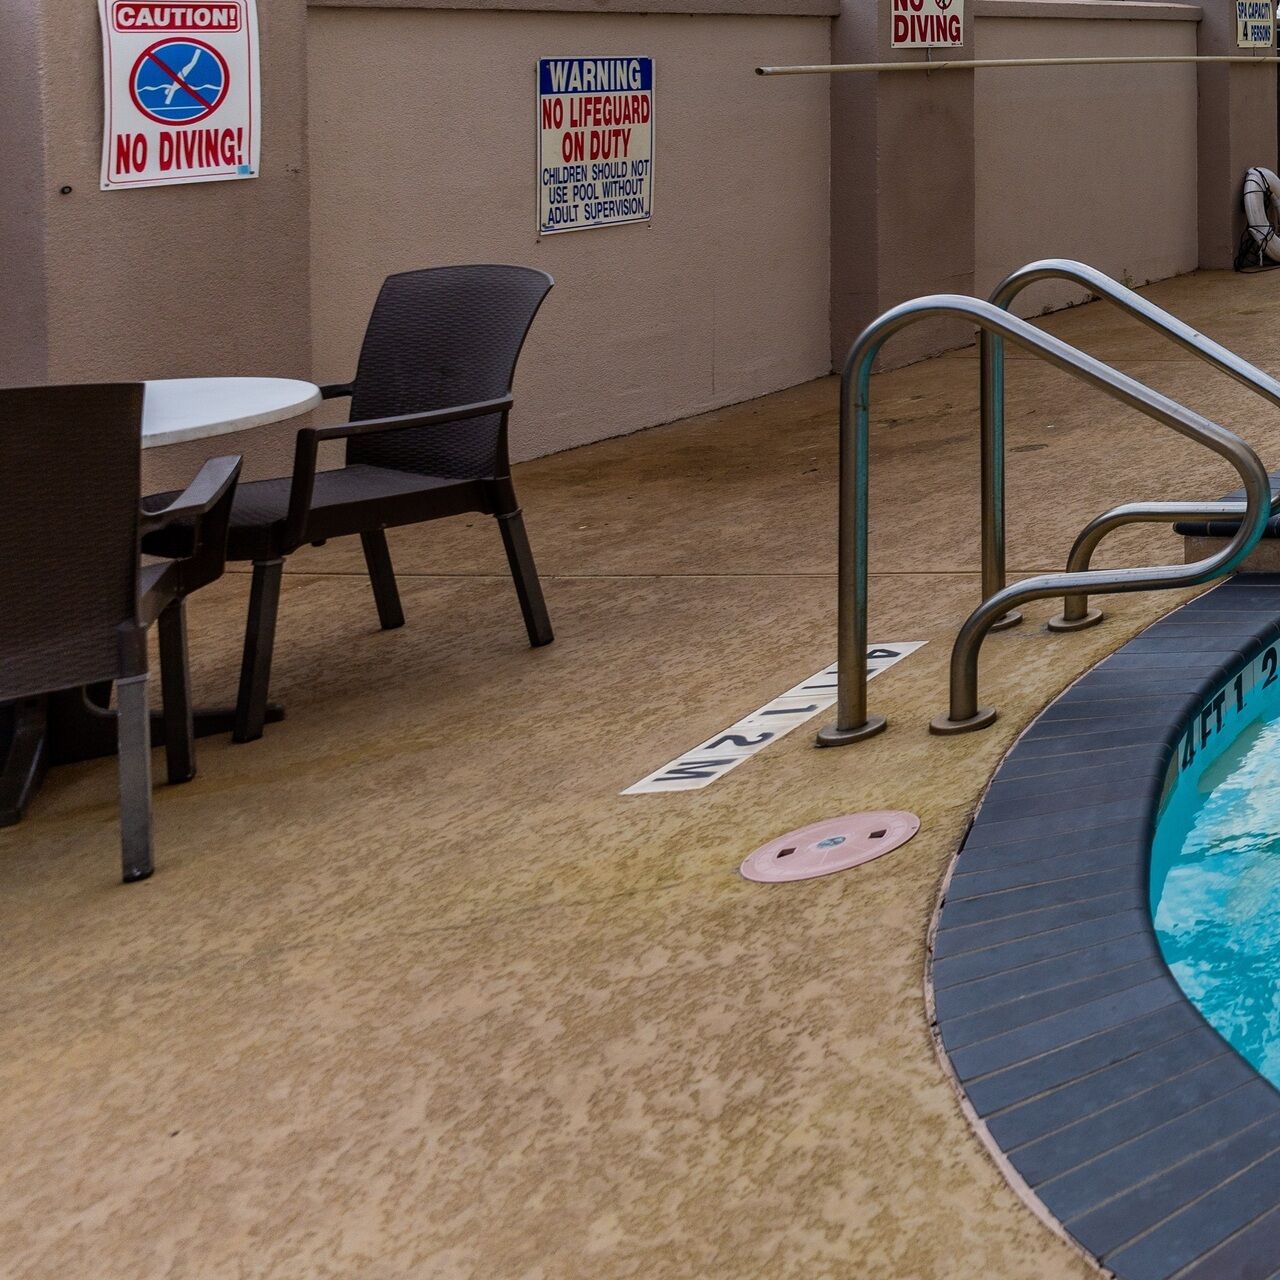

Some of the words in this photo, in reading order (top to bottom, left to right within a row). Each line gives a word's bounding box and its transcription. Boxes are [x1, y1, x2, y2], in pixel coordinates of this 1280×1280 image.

[117, 6, 236, 28] CAUTION!
[1238, 2, 1247, 19] SPA
[1248, 2, 1270, 20] CAPACITY
[894, 14, 961, 43] DIVING
[1242, 21, 1248, 40] 4
[1250, 24, 1271, 42] PERSONS
[550, 60, 642, 92] WARNING
[542, 98, 564, 130] NO
[570, 94, 650, 128] LIFEGUARD
[116, 133, 147, 174] NO
[159, 127, 244, 172] DIVING!
[562, 132, 584, 163] ON
[590, 128, 632, 160] DUTY
[542, 164, 588, 186] CHILDREN
[592, 162, 627, 180] SHOULD
[631, 160, 650, 176] NOT
[550, 186, 568, 204] USE
[573, 183, 600, 200] POOL
[602, 178, 644, 198] WITHOUT
[548, 204, 579, 225] ADULT
[584, 197, 644, 220] SUPERVISION
[1182, 725, 1196, 770] 4
[652, 758, 738, 782] M
